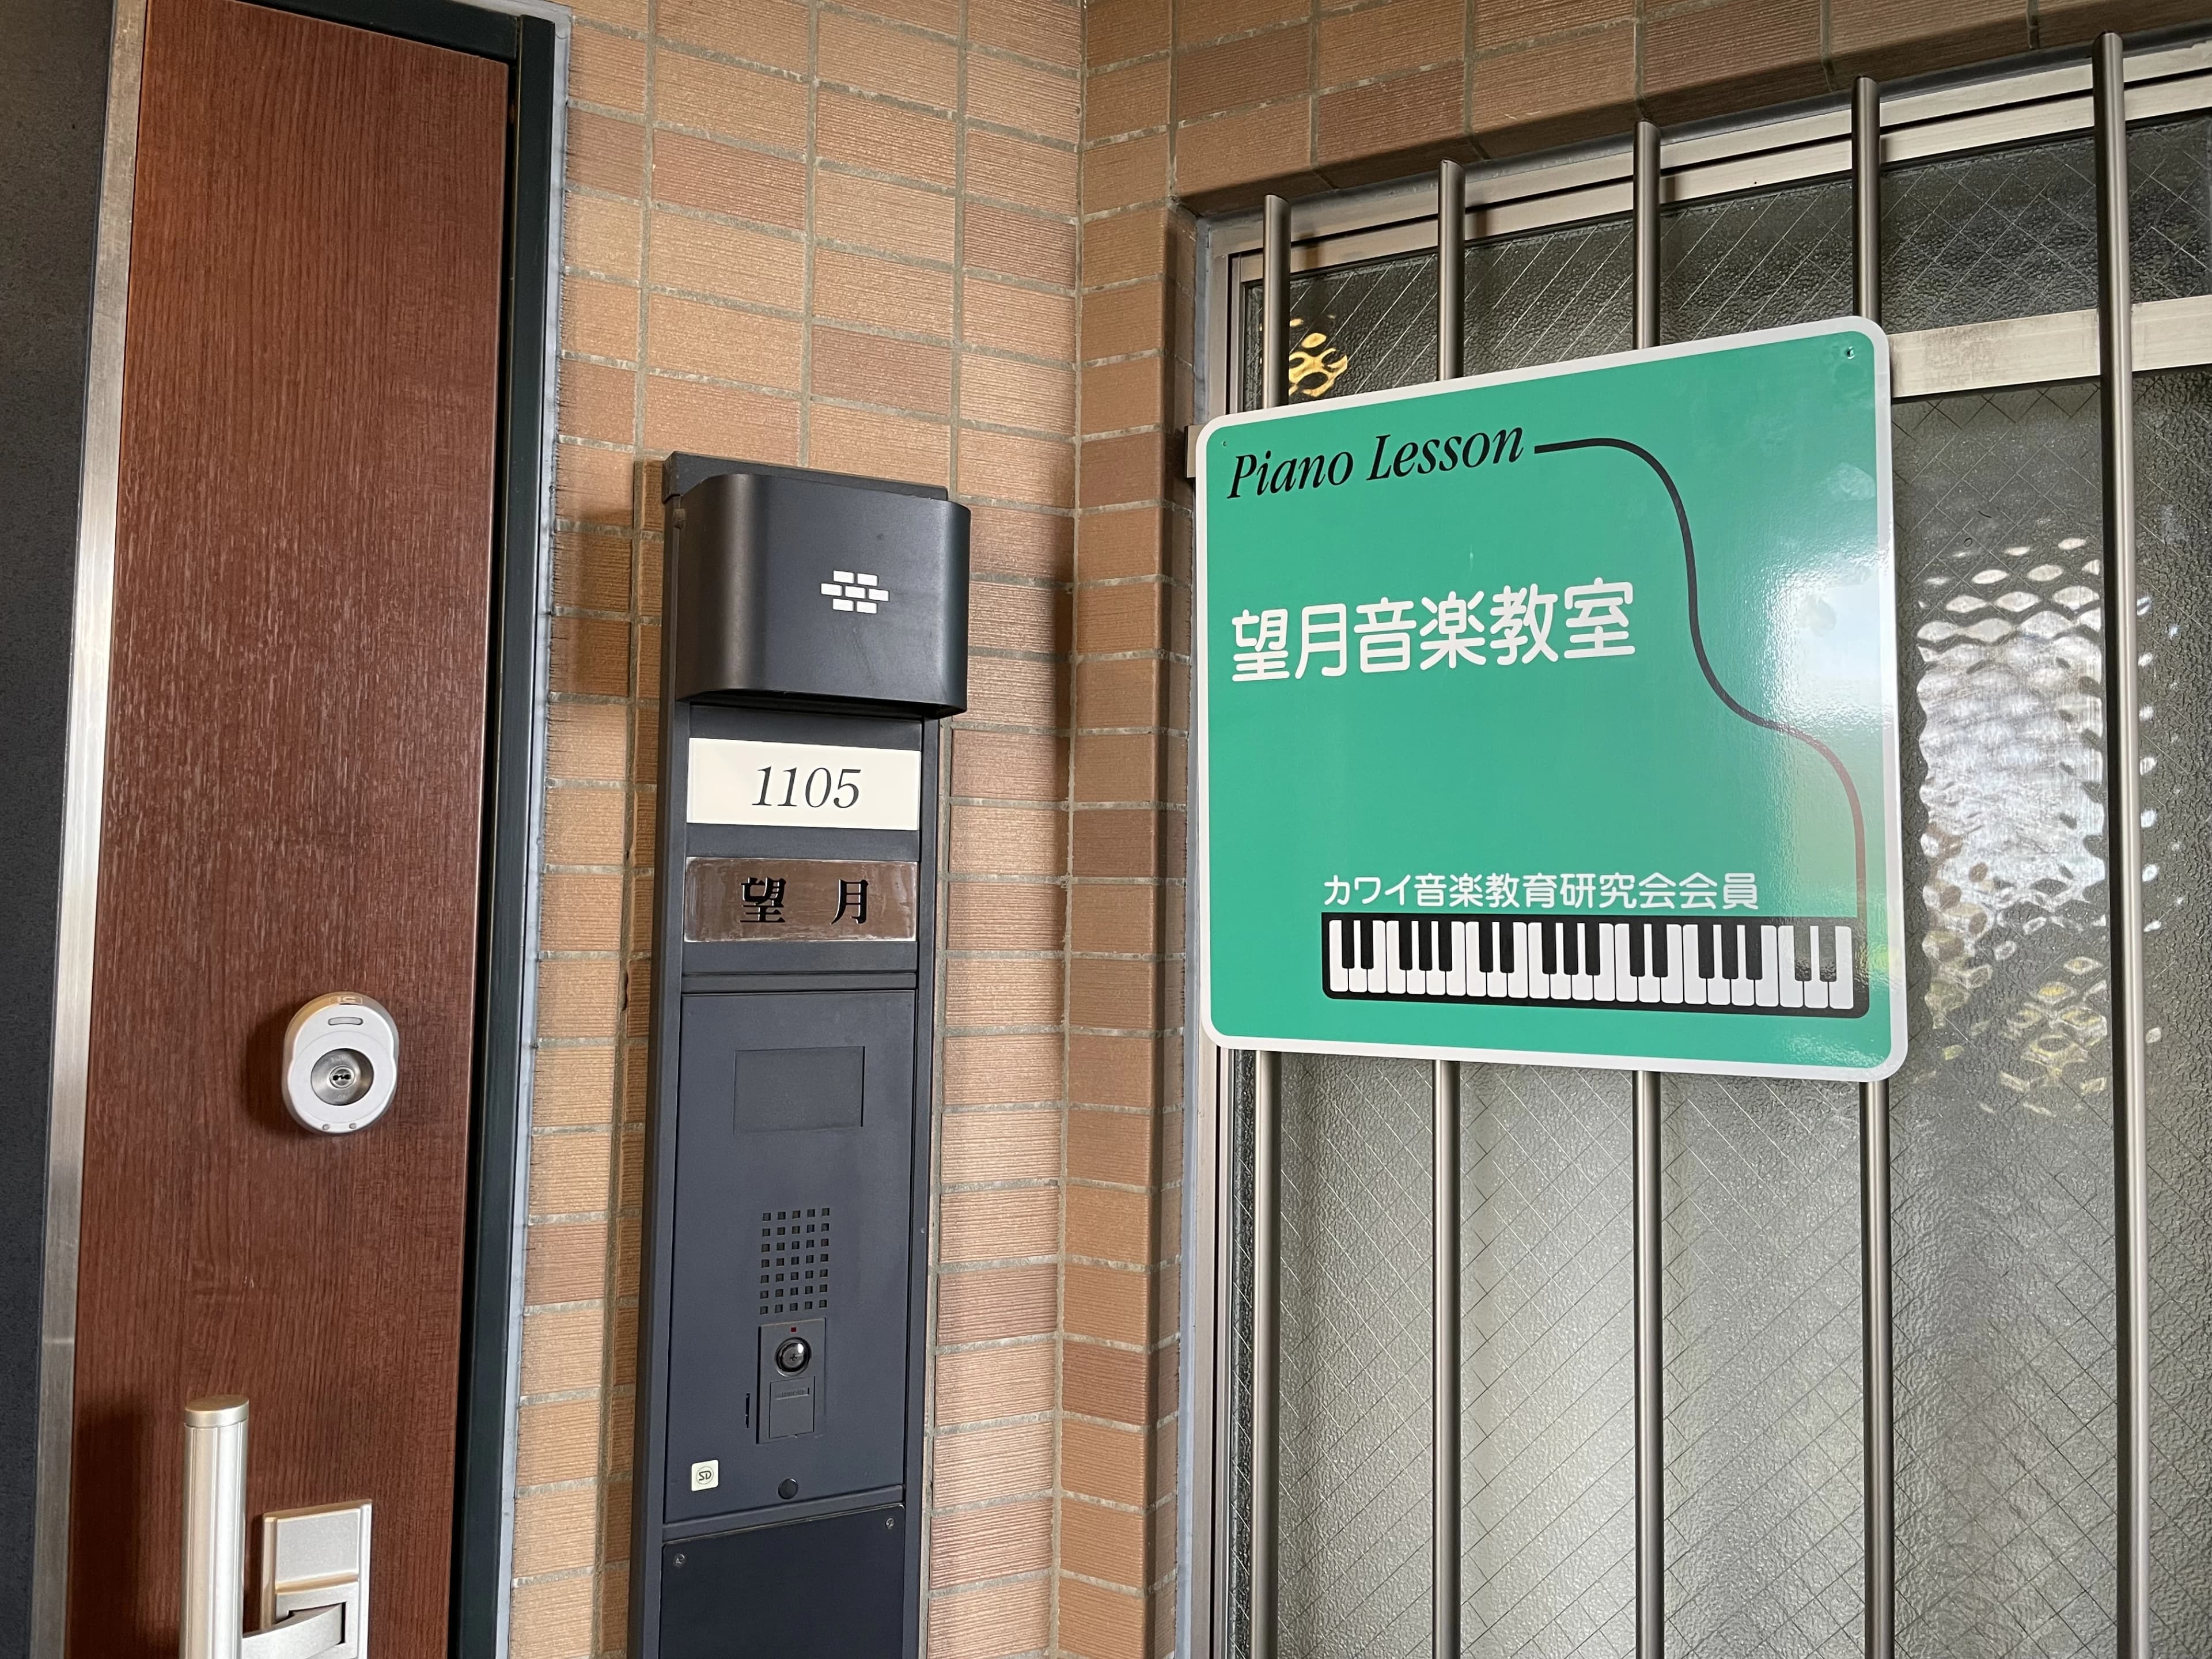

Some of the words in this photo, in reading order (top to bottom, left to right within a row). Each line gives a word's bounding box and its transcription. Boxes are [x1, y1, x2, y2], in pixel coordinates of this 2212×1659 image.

[1226, 450, 1354, 499] Piano
[1366, 427, 1524, 481] Lesson
[1232, 577, 1635, 682] 望月音楽教室
[752, 766, 862, 809] 1105
[1323, 872, 1759, 910] カワイ音楽教育研究会会員
